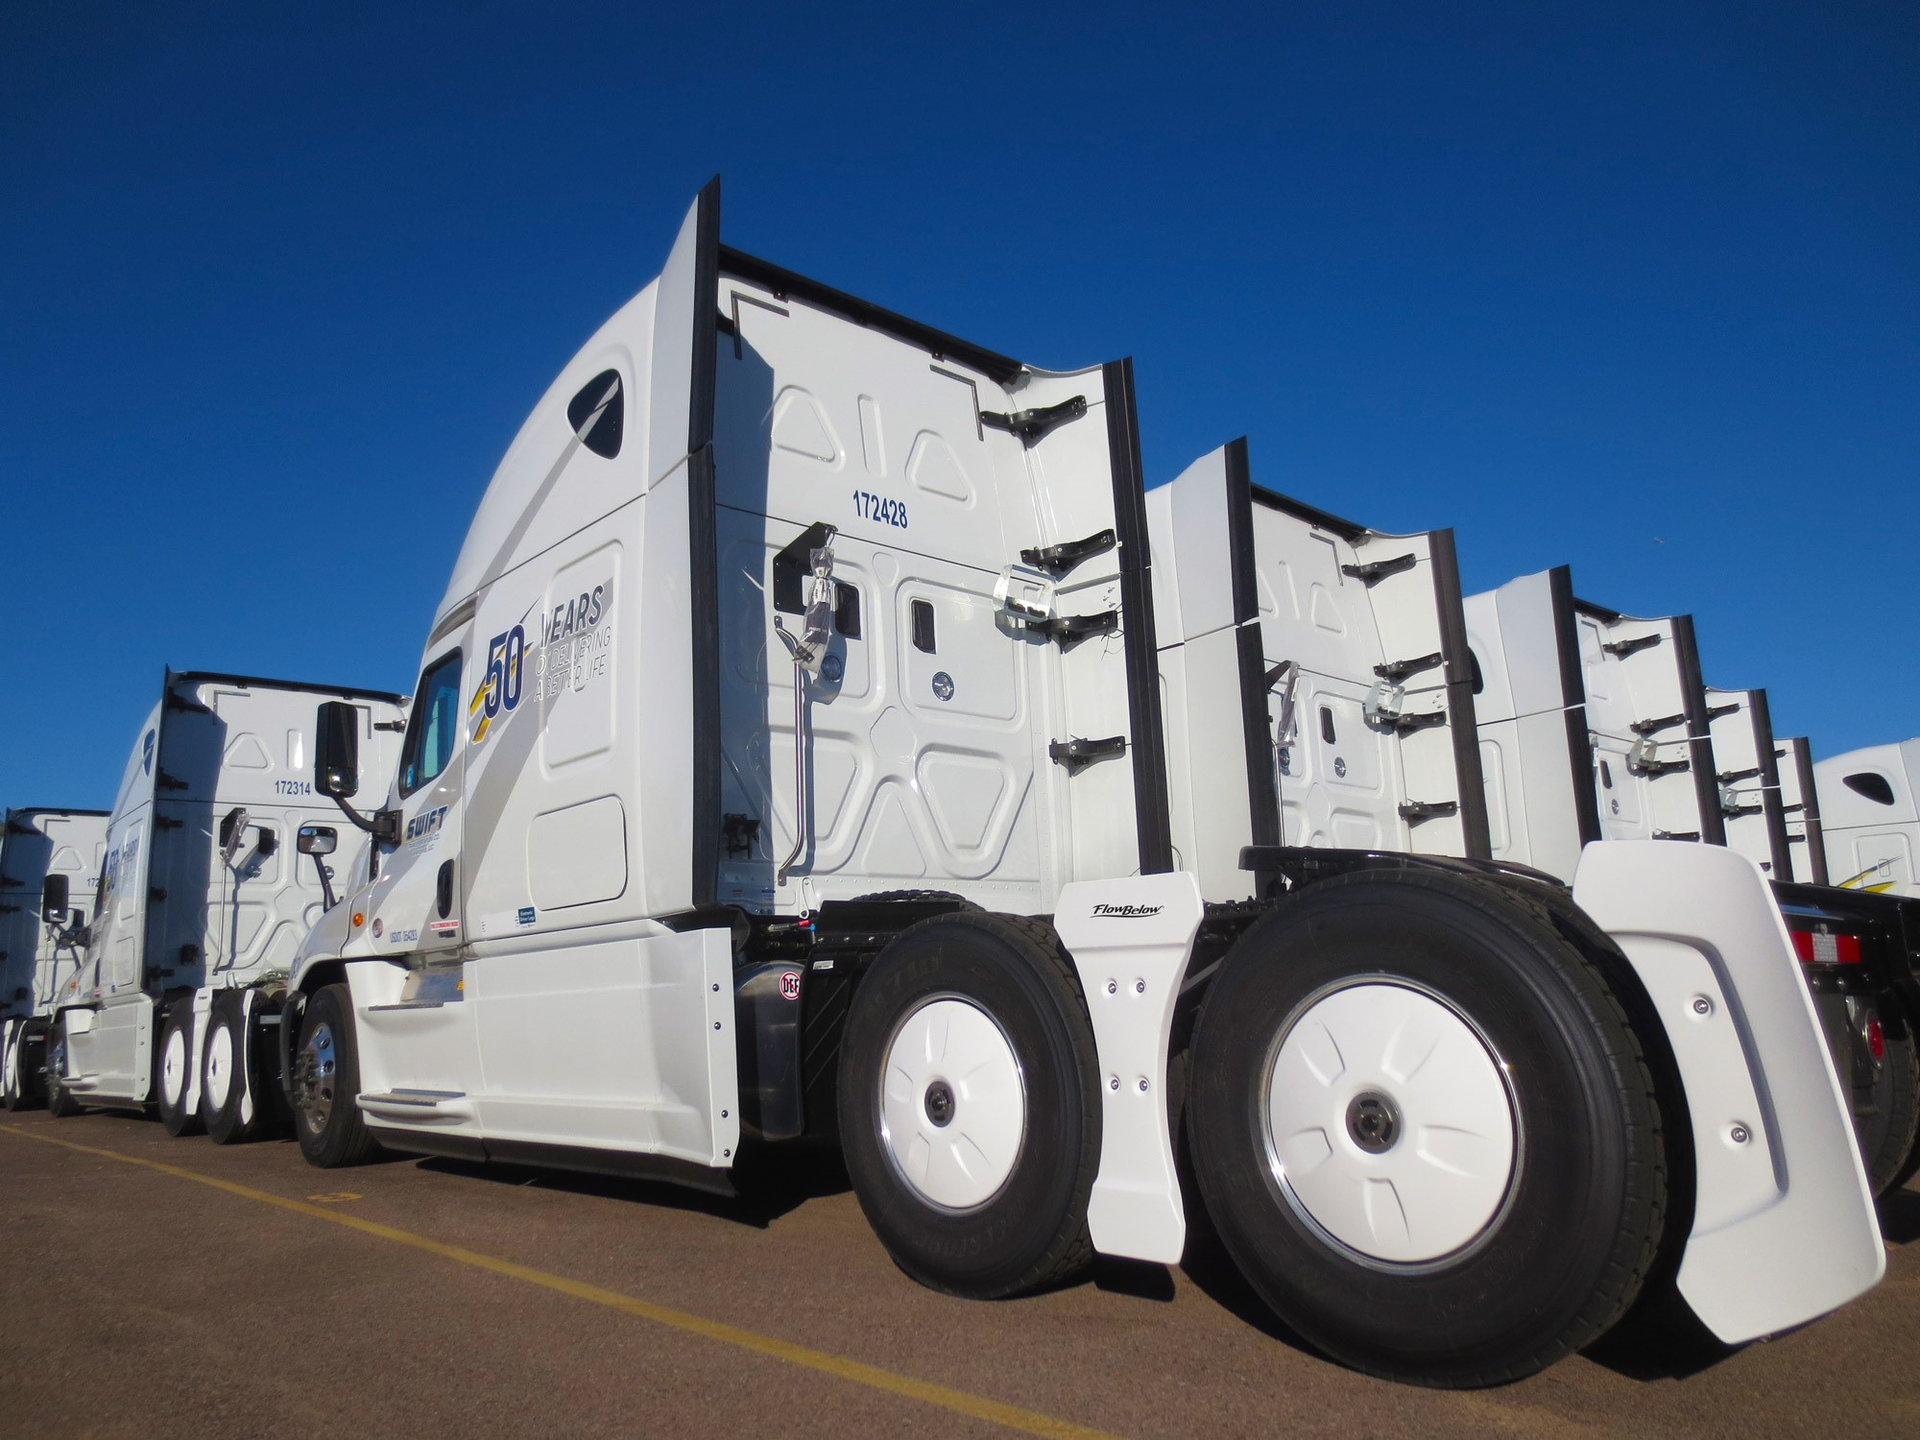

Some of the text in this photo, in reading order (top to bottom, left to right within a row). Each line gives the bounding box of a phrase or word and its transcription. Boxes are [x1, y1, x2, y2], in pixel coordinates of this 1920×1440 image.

[853, 489, 908, 529] 172428
[540, 584, 605, 649] YEARS
[484, 624, 525, 719] 50
[533, 680, 544, 702] A
[275, 780, 311, 796] 172314
[406, 805, 448, 840] SWIFT
[87, 877, 101, 888] 172
[1092, 903, 1165, 917] FlowBelow
[783, 978, 799, 993] DEF
